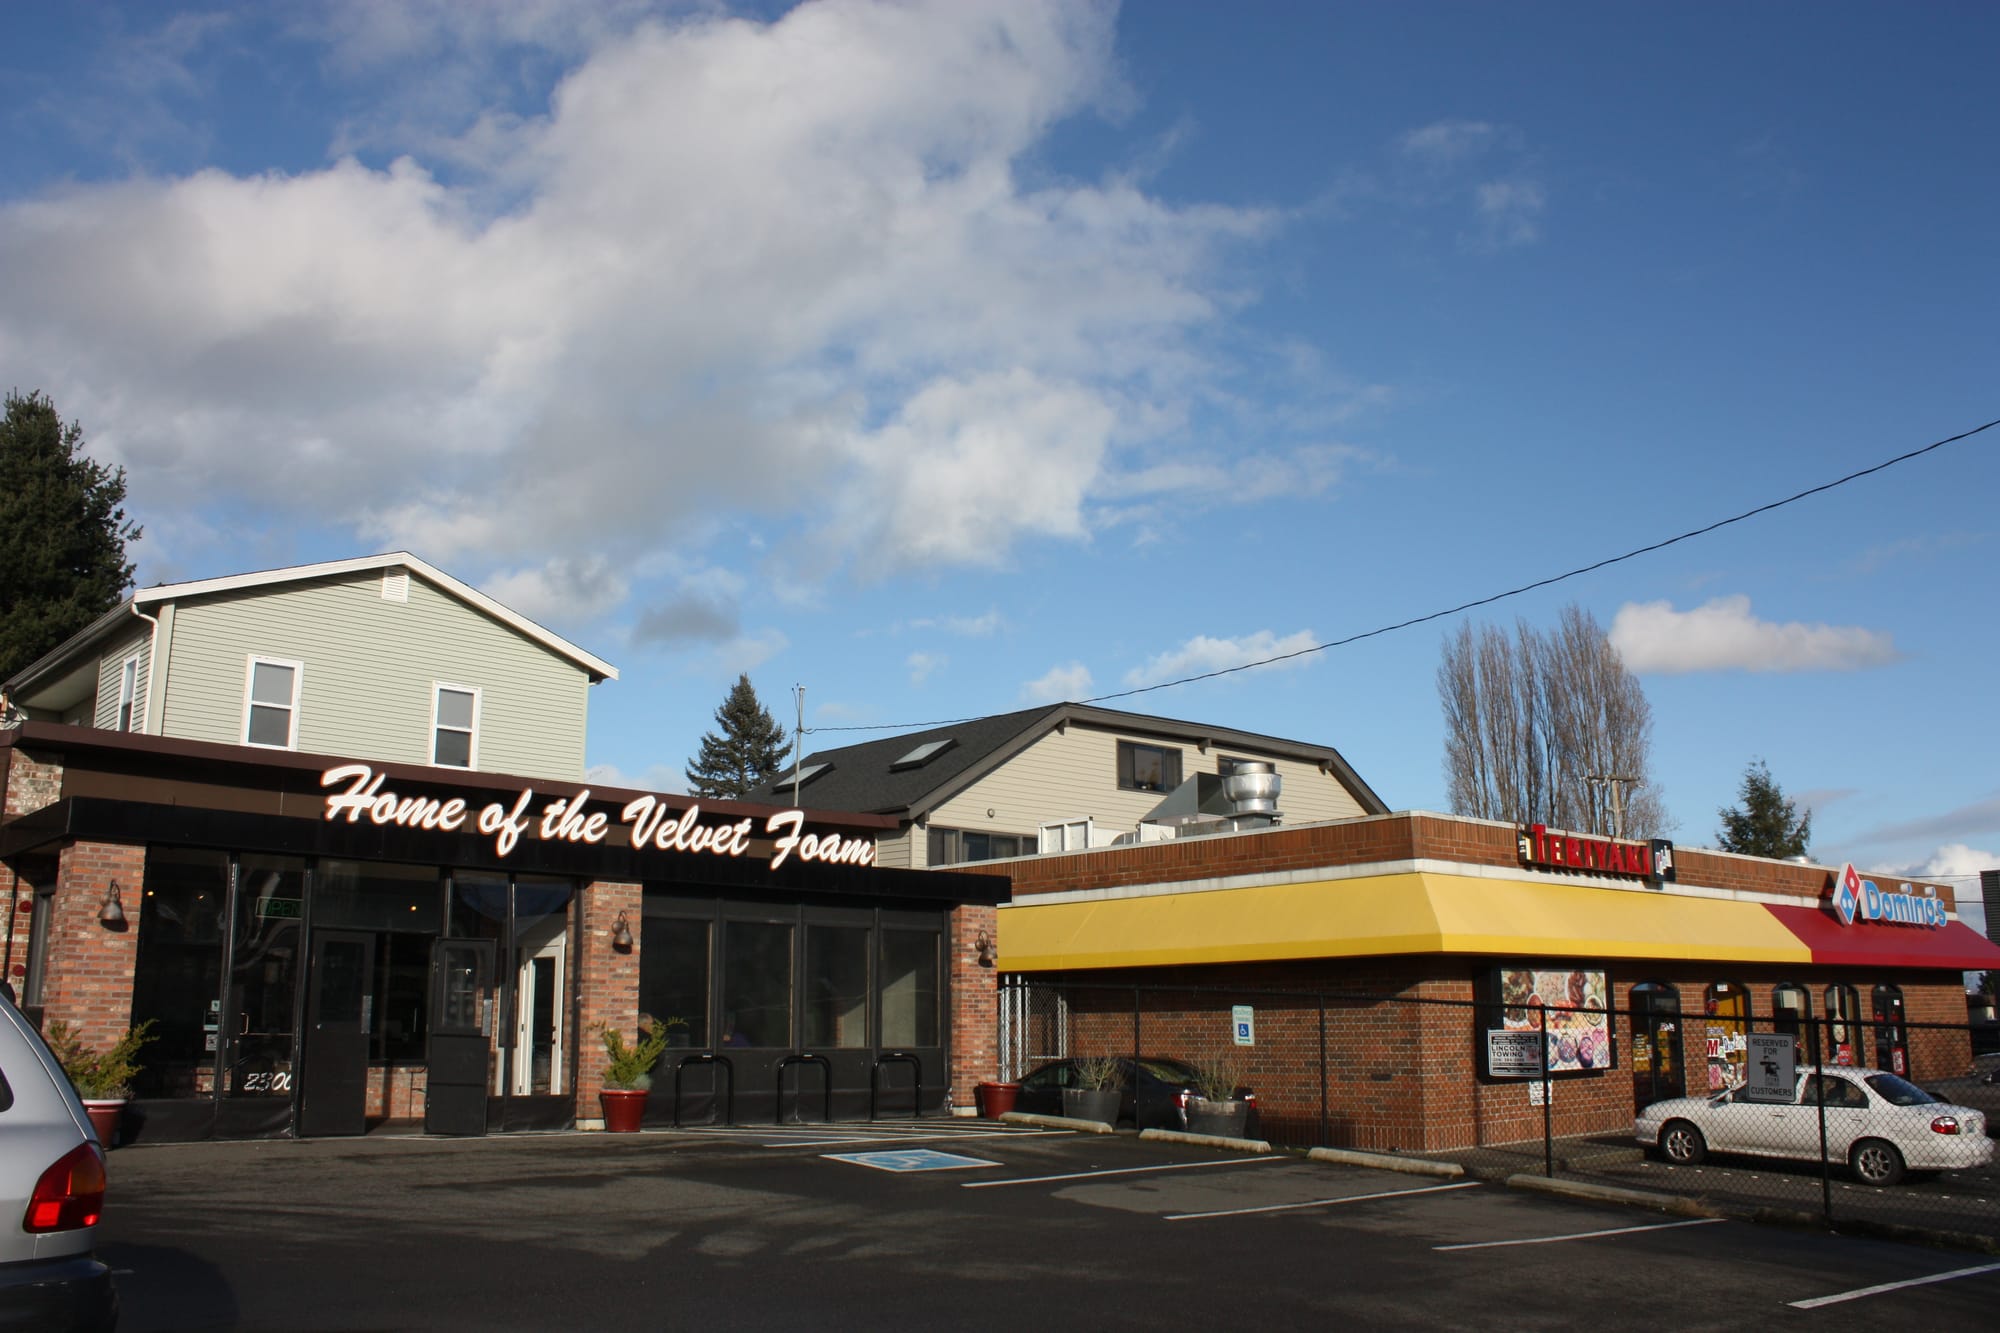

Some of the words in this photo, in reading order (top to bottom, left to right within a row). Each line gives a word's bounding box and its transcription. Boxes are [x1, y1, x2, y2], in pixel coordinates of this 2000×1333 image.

[321, 765, 466, 832] Home
[479, 788, 532, 857] of
[540, 789, 608, 843] the
[622, 796, 752, 856] Velvet
[765, 811, 874, 871] Foam
[1531, 823, 1651, 876] TERIYAKI
[1859, 880, 1947, 927] Domino's
[1752, 1038, 1789, 1048] RESERVED
[1763, 1047, 1777, 1056] FOR
[1750, 1087, 1793, 1097] CUSTOMERS
